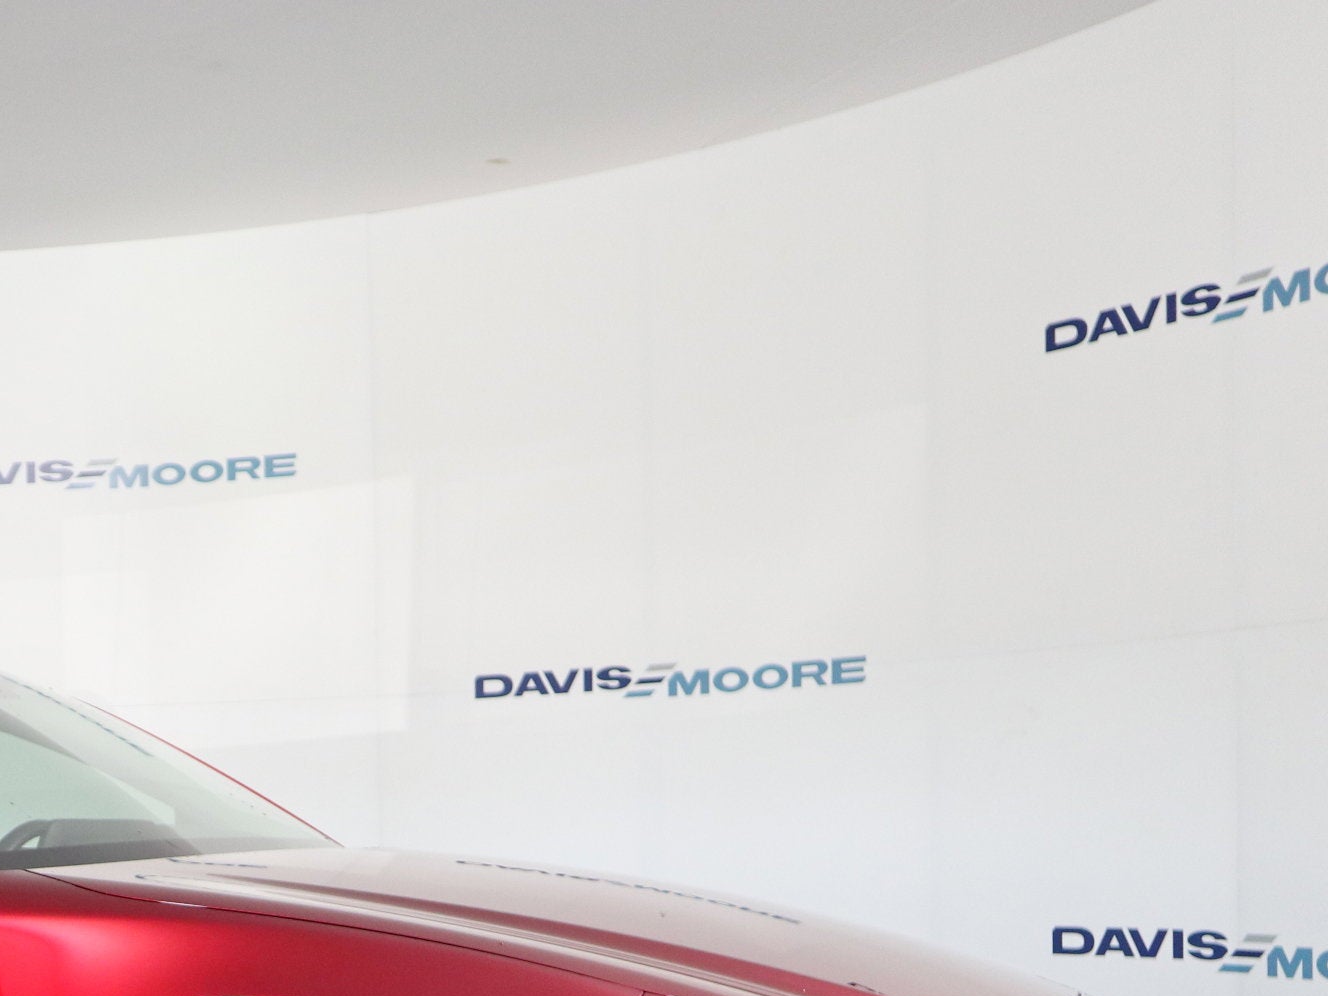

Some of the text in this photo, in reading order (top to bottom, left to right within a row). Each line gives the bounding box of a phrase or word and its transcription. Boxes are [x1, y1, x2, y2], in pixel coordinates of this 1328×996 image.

[1045, 283, 1221, 353] DAVIS
[109, 453, 298, 490] MOORE
[475, 656, 867, 699] DAVIS MOORE
[1052, 925, 1228, 961] DAVIS
